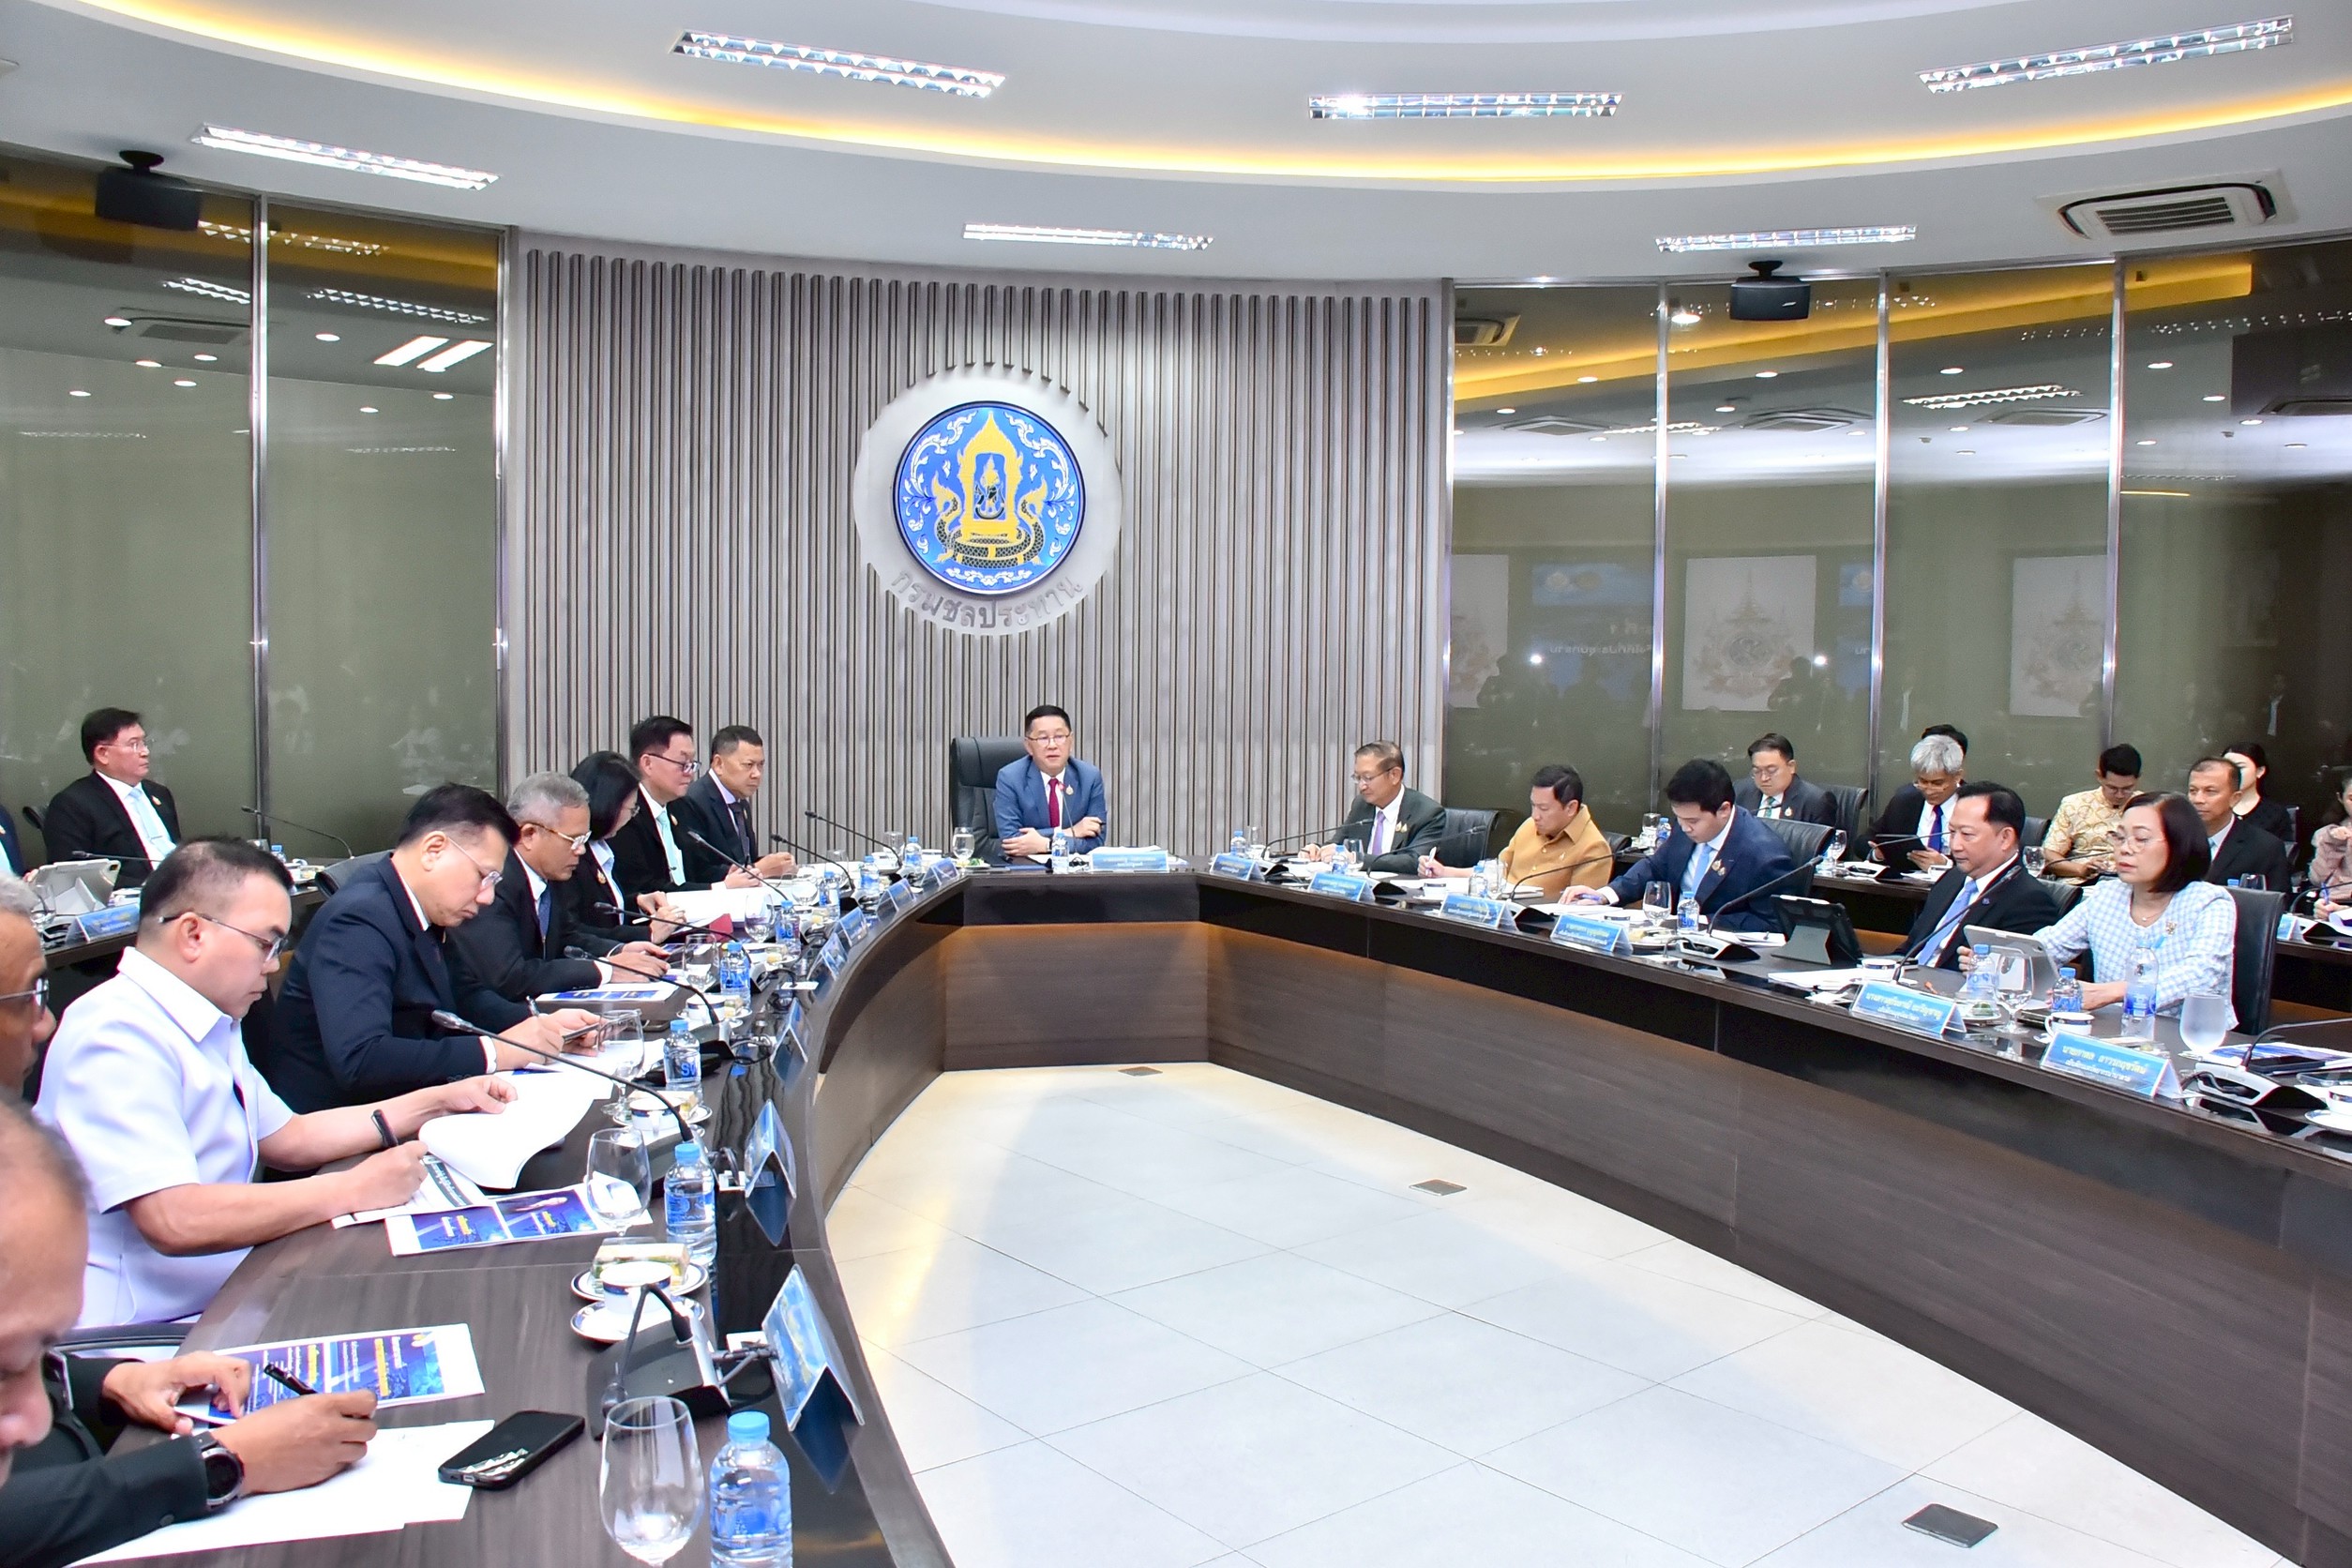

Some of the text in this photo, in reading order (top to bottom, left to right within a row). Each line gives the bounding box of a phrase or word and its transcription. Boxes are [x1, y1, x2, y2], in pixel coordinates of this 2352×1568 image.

[891, 571, 1084, 628] กรมชลประทาน
